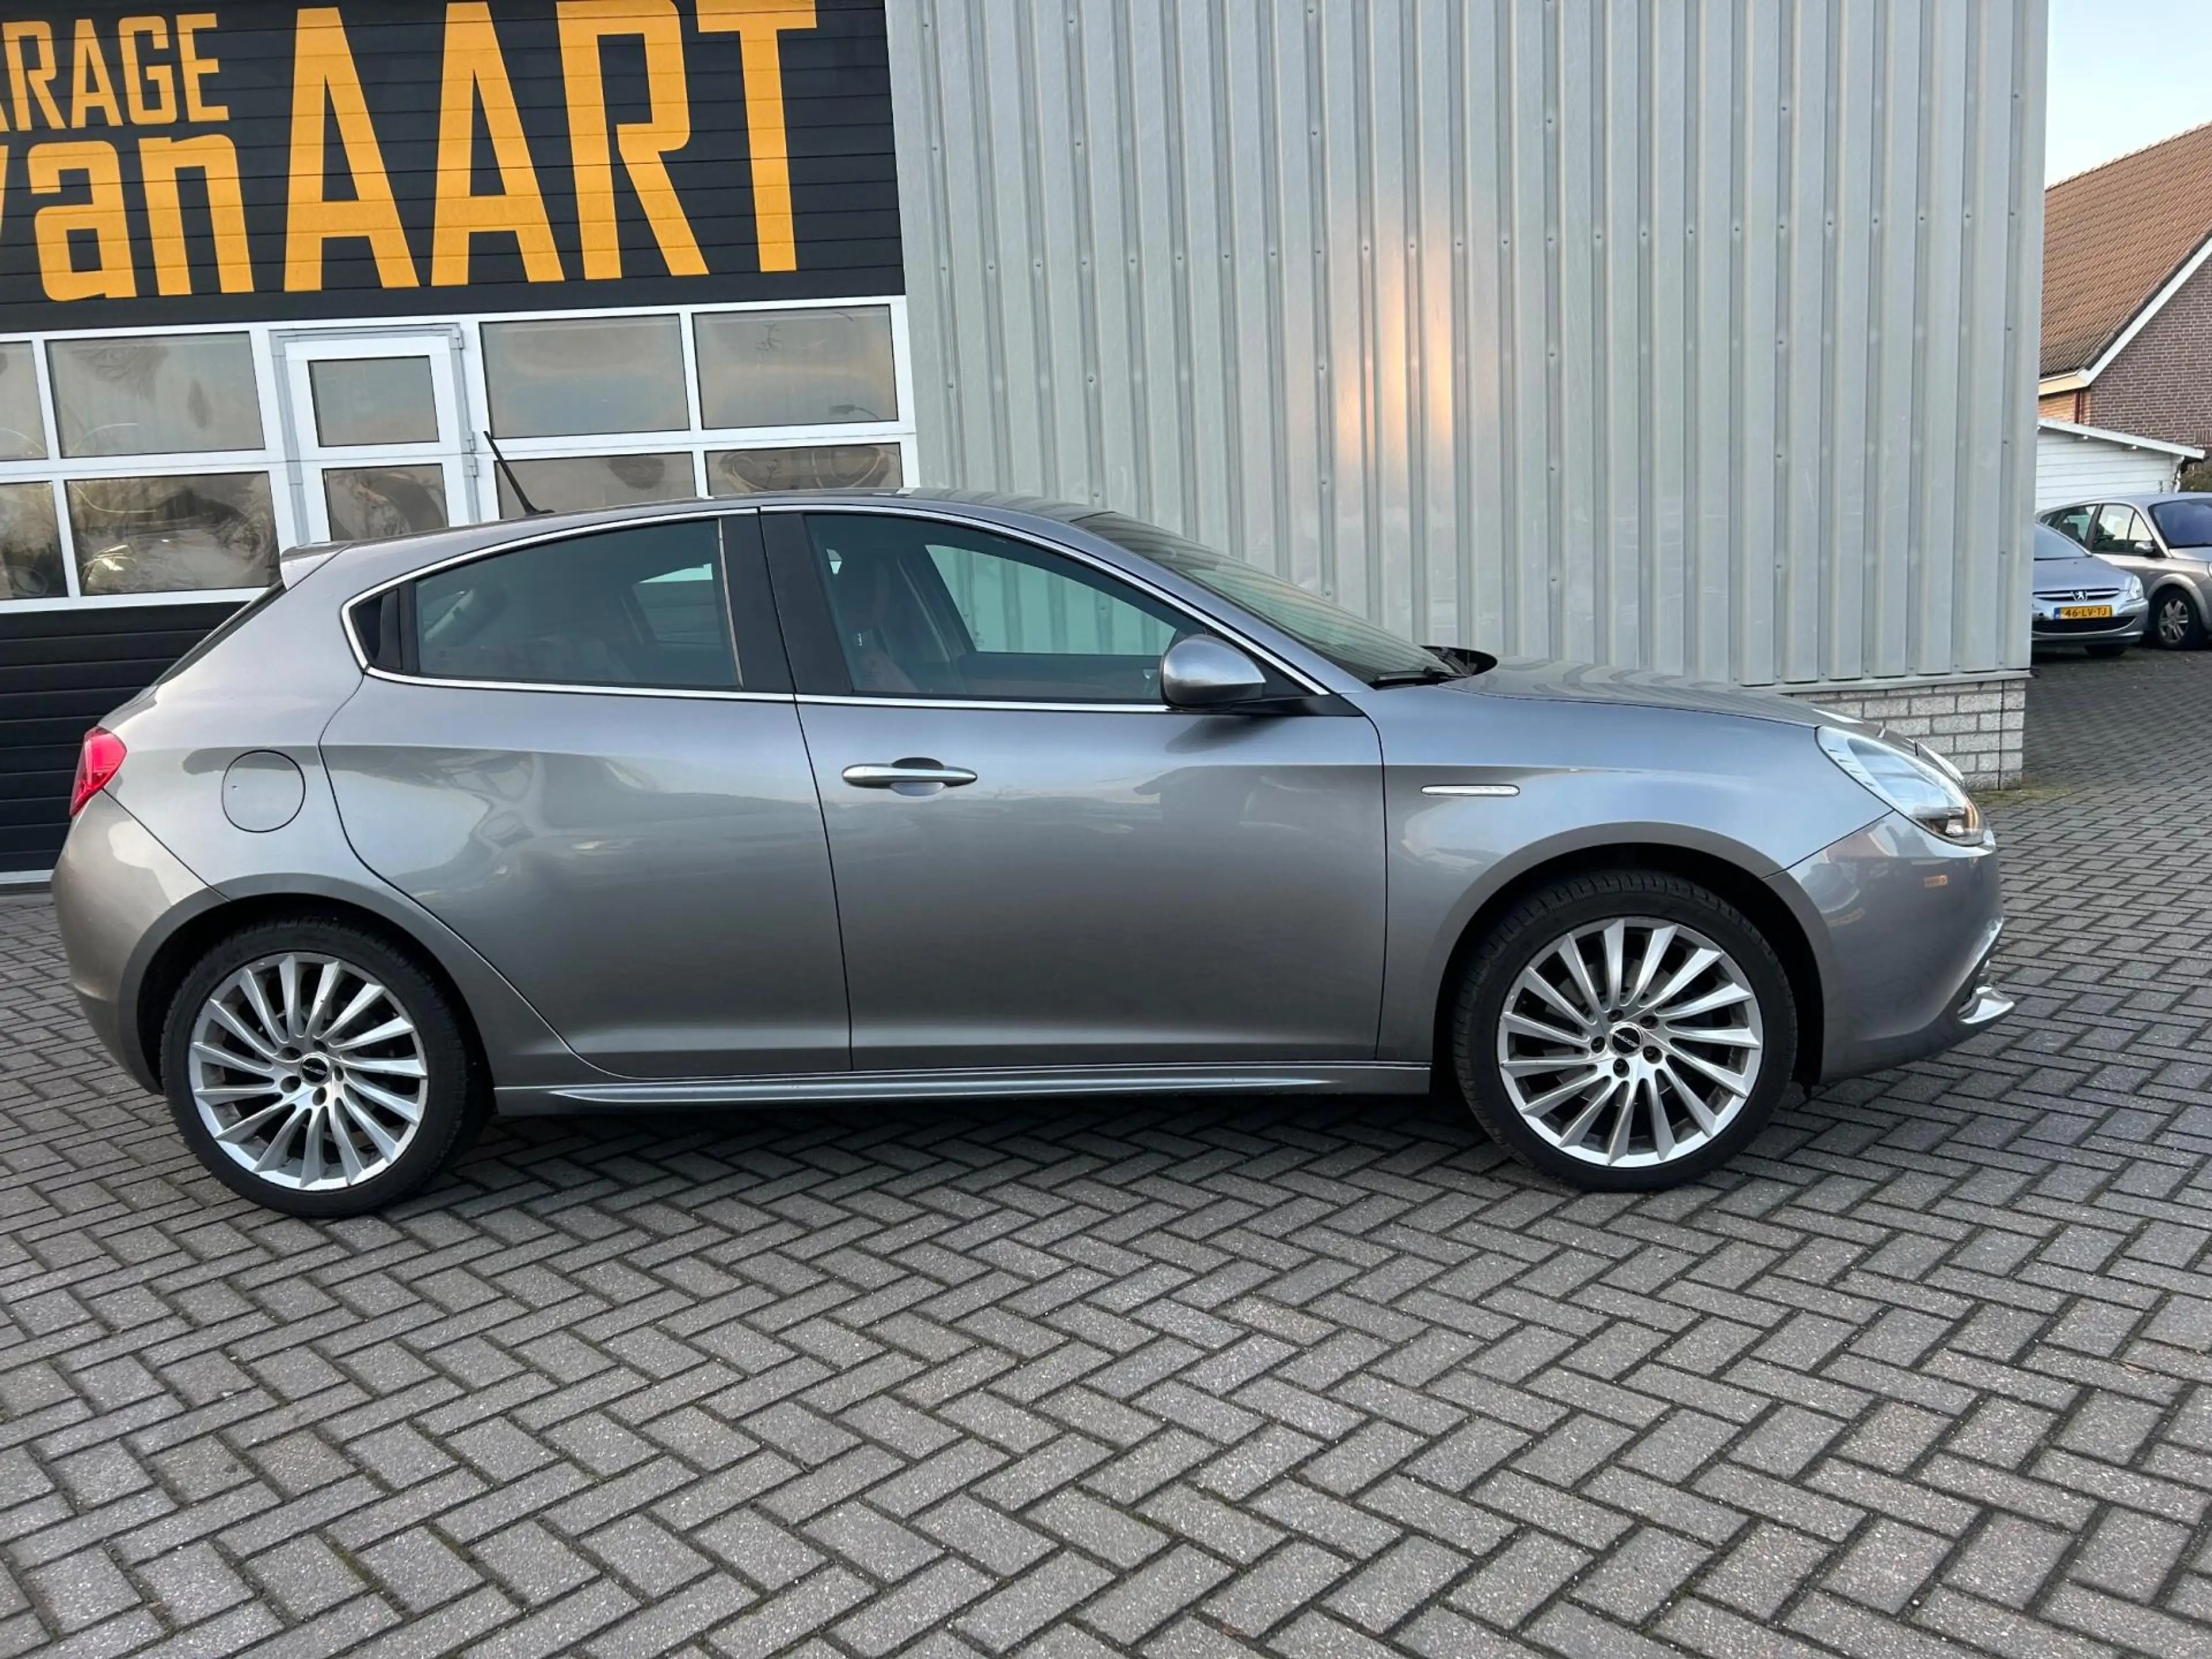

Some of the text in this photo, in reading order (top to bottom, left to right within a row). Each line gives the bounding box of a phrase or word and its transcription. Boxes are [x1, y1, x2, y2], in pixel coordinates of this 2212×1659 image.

[0, 13, 229, 132] RAGE
[0, 0, 817, 301] an AART
[2064, 607, 2107, 618] 46-LV-TJ
